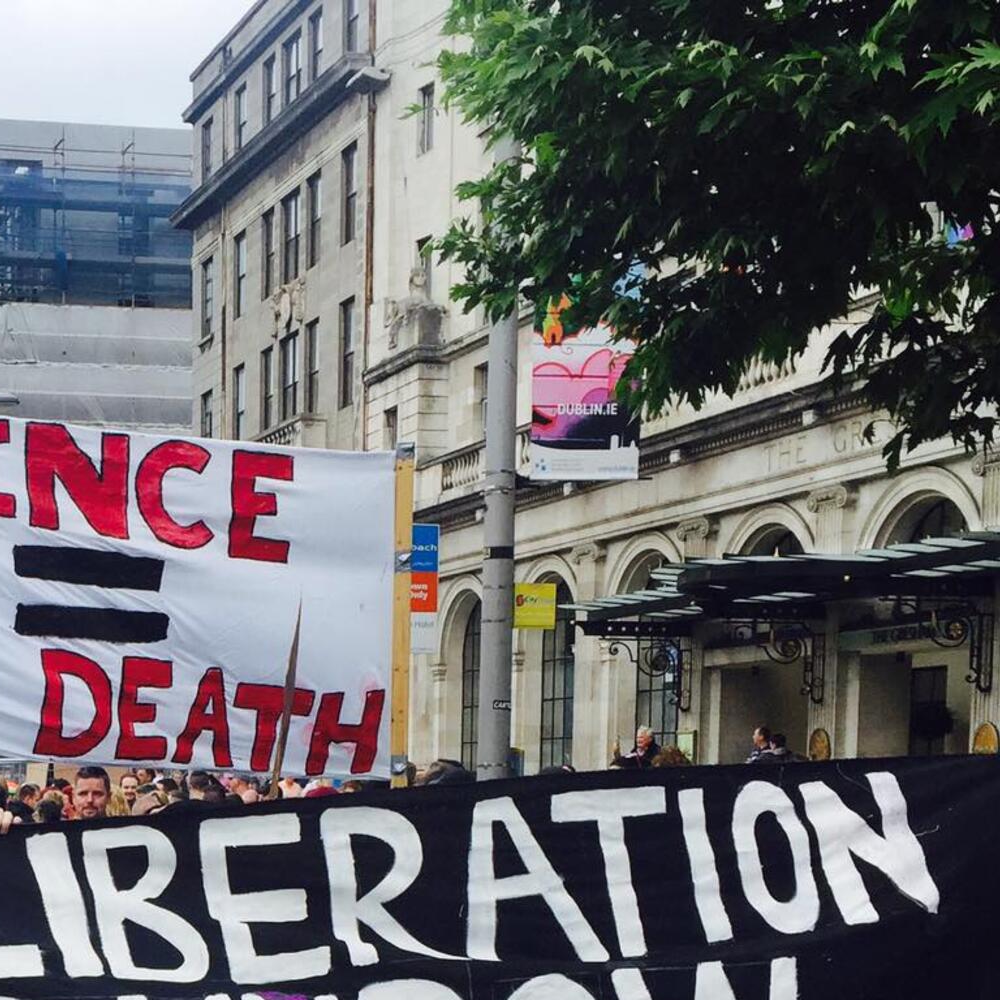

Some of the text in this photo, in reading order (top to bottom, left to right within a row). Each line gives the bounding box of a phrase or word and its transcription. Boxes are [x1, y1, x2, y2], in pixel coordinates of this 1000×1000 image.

[557, 403, 618, 416] DUBLIN.IE
[763, 434, 807, 473] THE
[33, 647, 385, 775] DEATH
